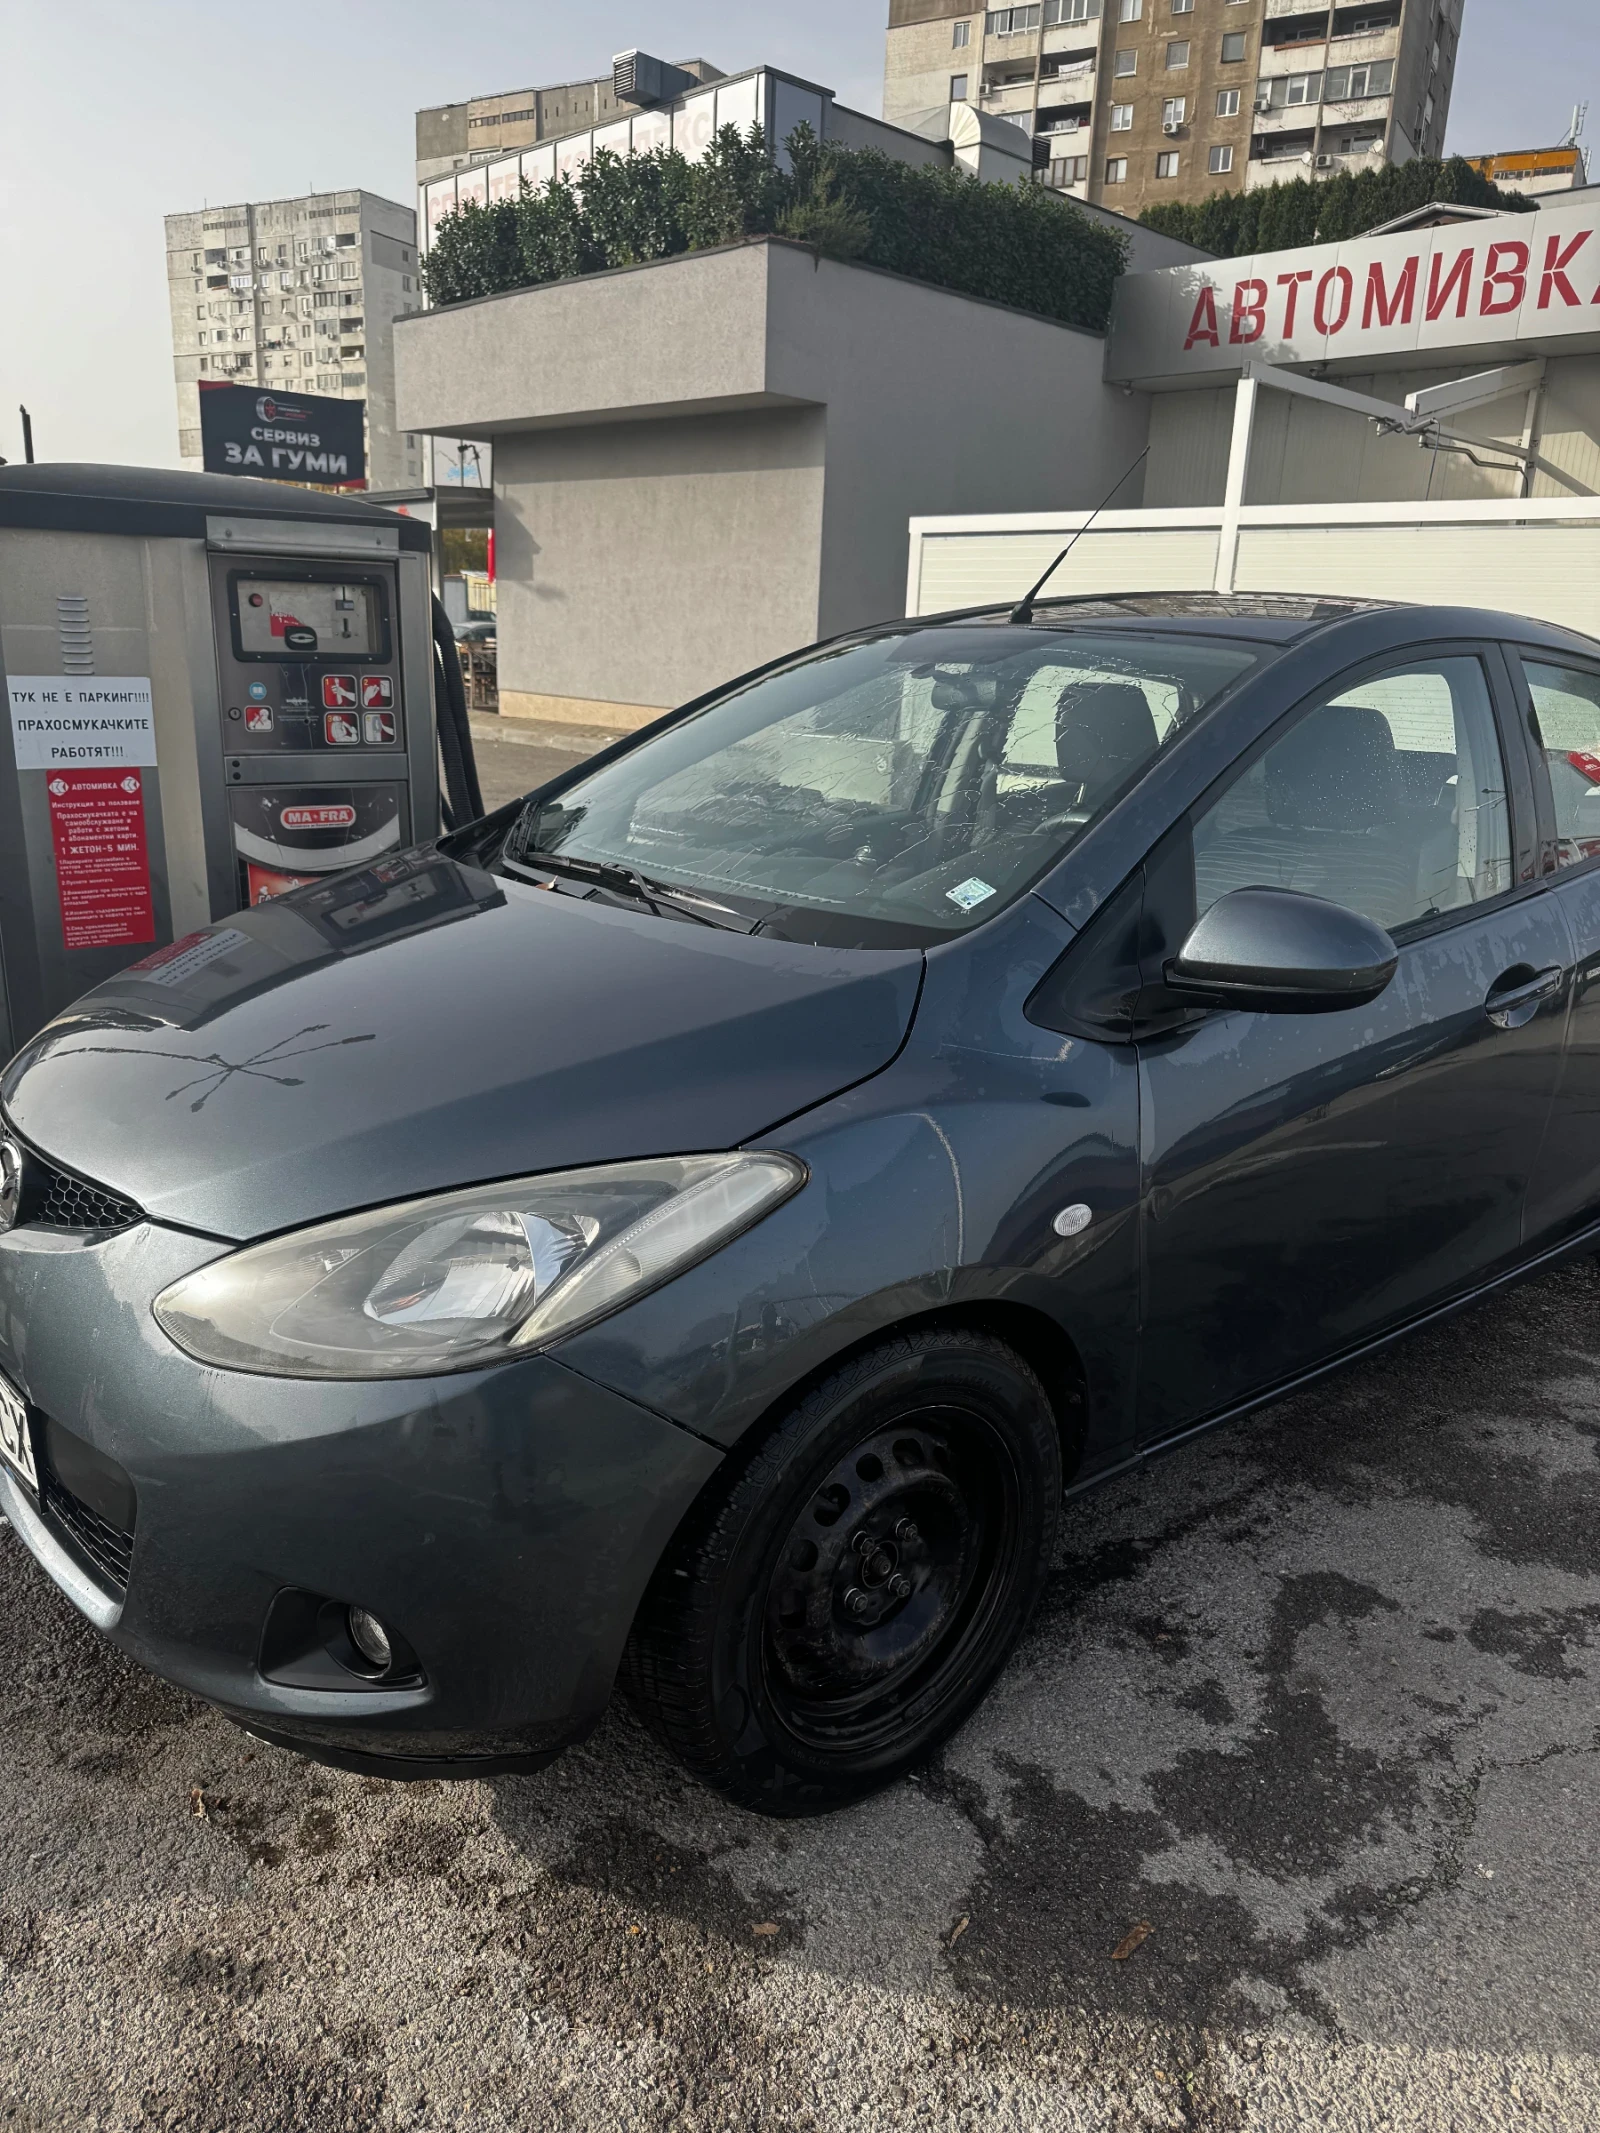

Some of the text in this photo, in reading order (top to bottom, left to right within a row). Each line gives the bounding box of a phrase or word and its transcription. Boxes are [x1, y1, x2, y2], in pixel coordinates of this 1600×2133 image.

[1183, 229, 1600, 350] АВТОМИВК
[251, 427, 321, 447] СЕРВИЗ
[224, 442, 348, 475] ЗА ГУМИ
[12, 692, 149, 702] ТУК НЕ Е ПАРКИНГ!!!!
[18, 719, 149, 731] ПРАХОСМУКАЧКИТЕ
[51, 746, 124, 758] РАБОТЯТ!!!
[57, 811, 119, 820] Прахосмукачката
[65, 818, 124, 827] самообслужване
[68, 833, 114, 841] абонаментни
[70, 845, 113, 854] ЖЕТОН-5
